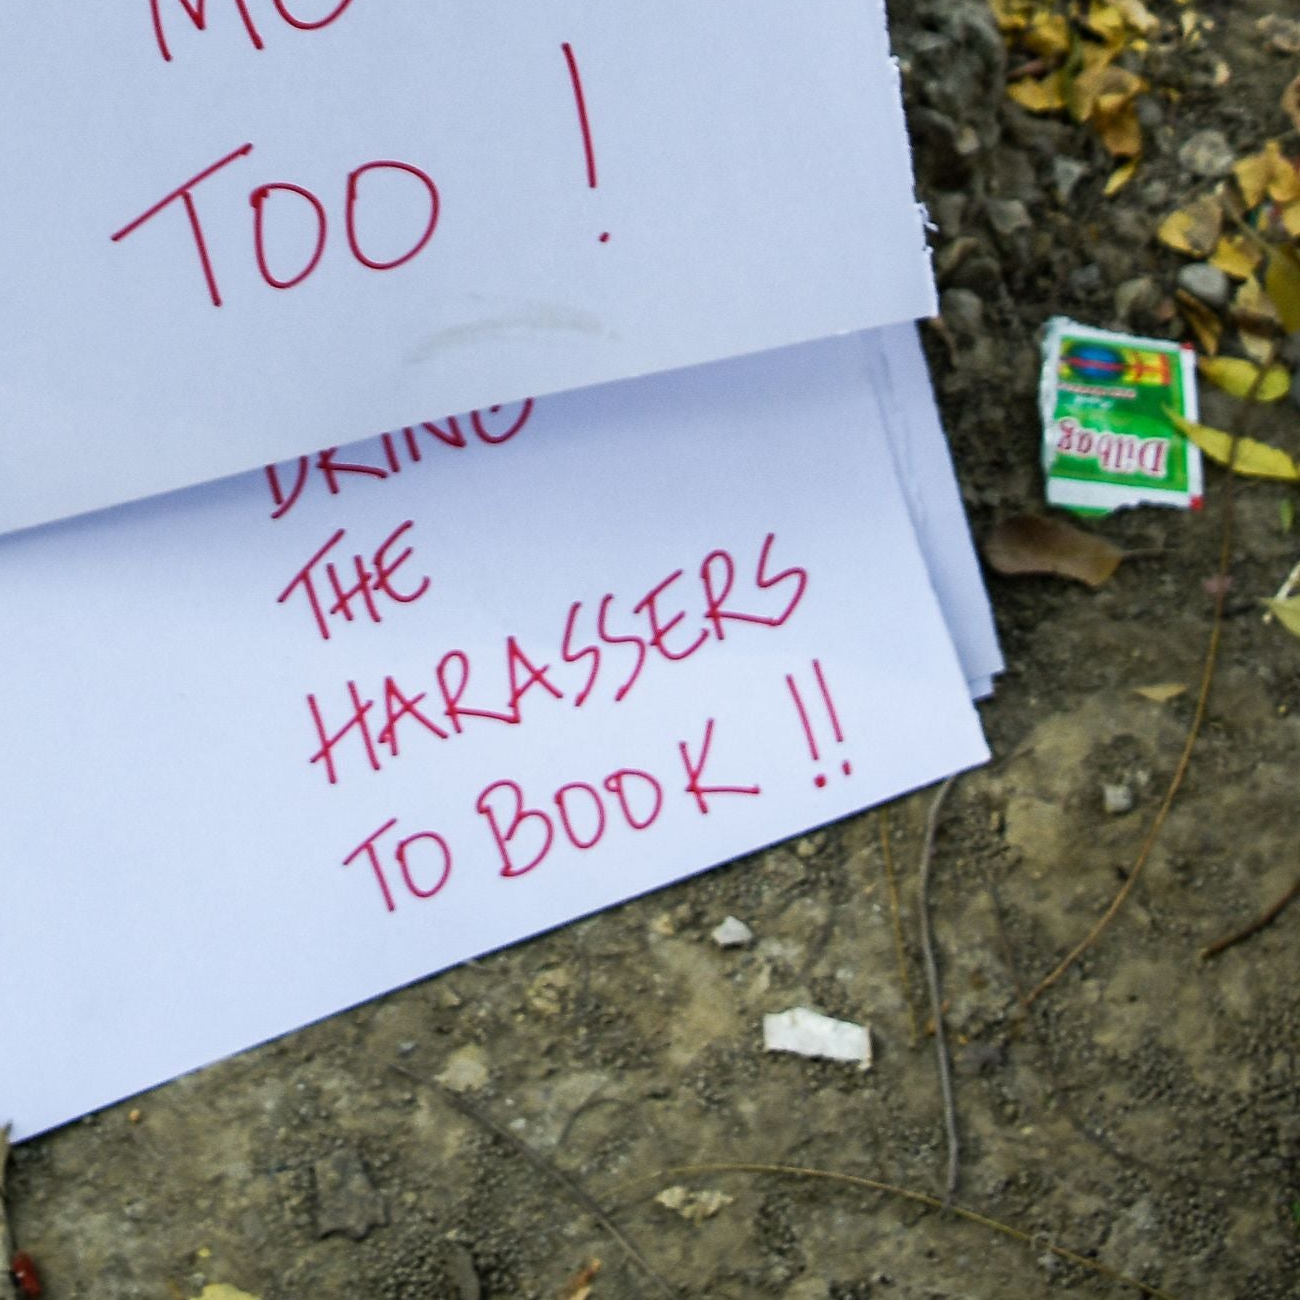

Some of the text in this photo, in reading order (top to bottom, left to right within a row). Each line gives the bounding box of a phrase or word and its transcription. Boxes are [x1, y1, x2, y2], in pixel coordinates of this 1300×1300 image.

[111, 143, 441, 308] TOO
[278, 519, 432, 641] THE
[306, 533, 809, 786] HARASSERS
[343, 818, 454, 912] TO
[474, 718, 762, 880] BOOK
